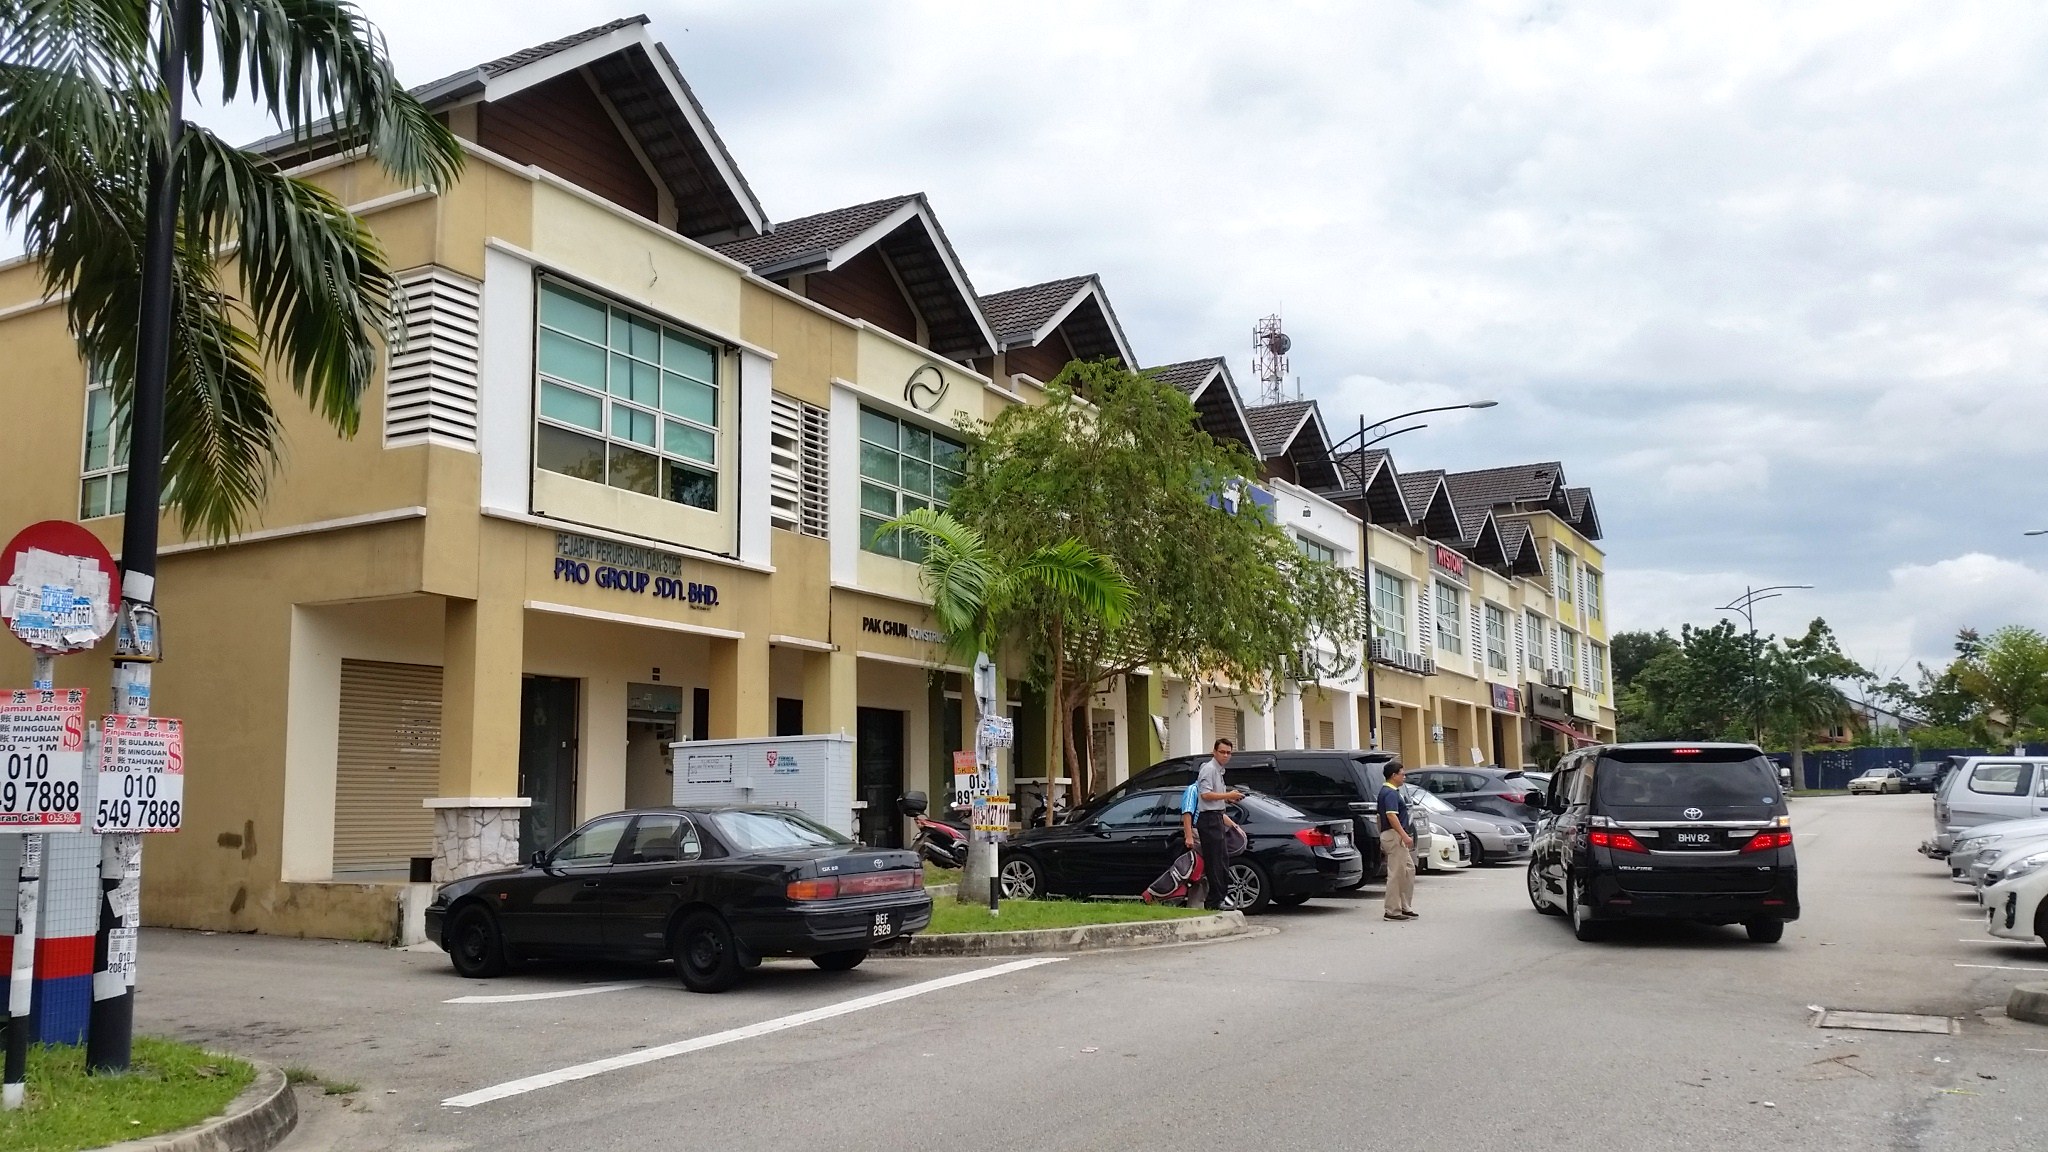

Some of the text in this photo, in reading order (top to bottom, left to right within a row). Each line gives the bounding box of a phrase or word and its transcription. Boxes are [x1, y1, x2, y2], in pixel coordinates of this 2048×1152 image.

[557, 533, 596, 559] PEJABAT
[646, 552, 662, 573] DAN
[663, 554, 683, 576] STOR
[554, 557, 590, 585] PRO
[595, 566, 650, 594] GROUP
[688, 582, 720, 606] BHD.
[862, 616, 882, 634] PAK
[883, 620, 908, 638] CHUN
[36, 704, 81, 712] Berlesen
[12, 735, 59, 743] TAHUNAN
[105, 728, 179, 739] Pinjaman Berlesen
[38, 744, 58, 752] 1M
[128, 739, 165, 747] BULANAN
[8, 753, 48, 780] 010
[127, 758, 165, 766] TAHUNAN
[102, 765, 131, 773] 1000
[146, 766, 163, 774] 1M
[123, 774, 157, 799] 010
[0, 781, 80, 813] 9 7888
[0, 814, 18, 822] ran
[21, 813, 41, 822] Cek
[96, 799, 181, 828] 549 7888
[1678, 833, 1710, 842] BHV 82
[875, 913, 889, 925] BEF
[873, 924, 892, 937] 2929
